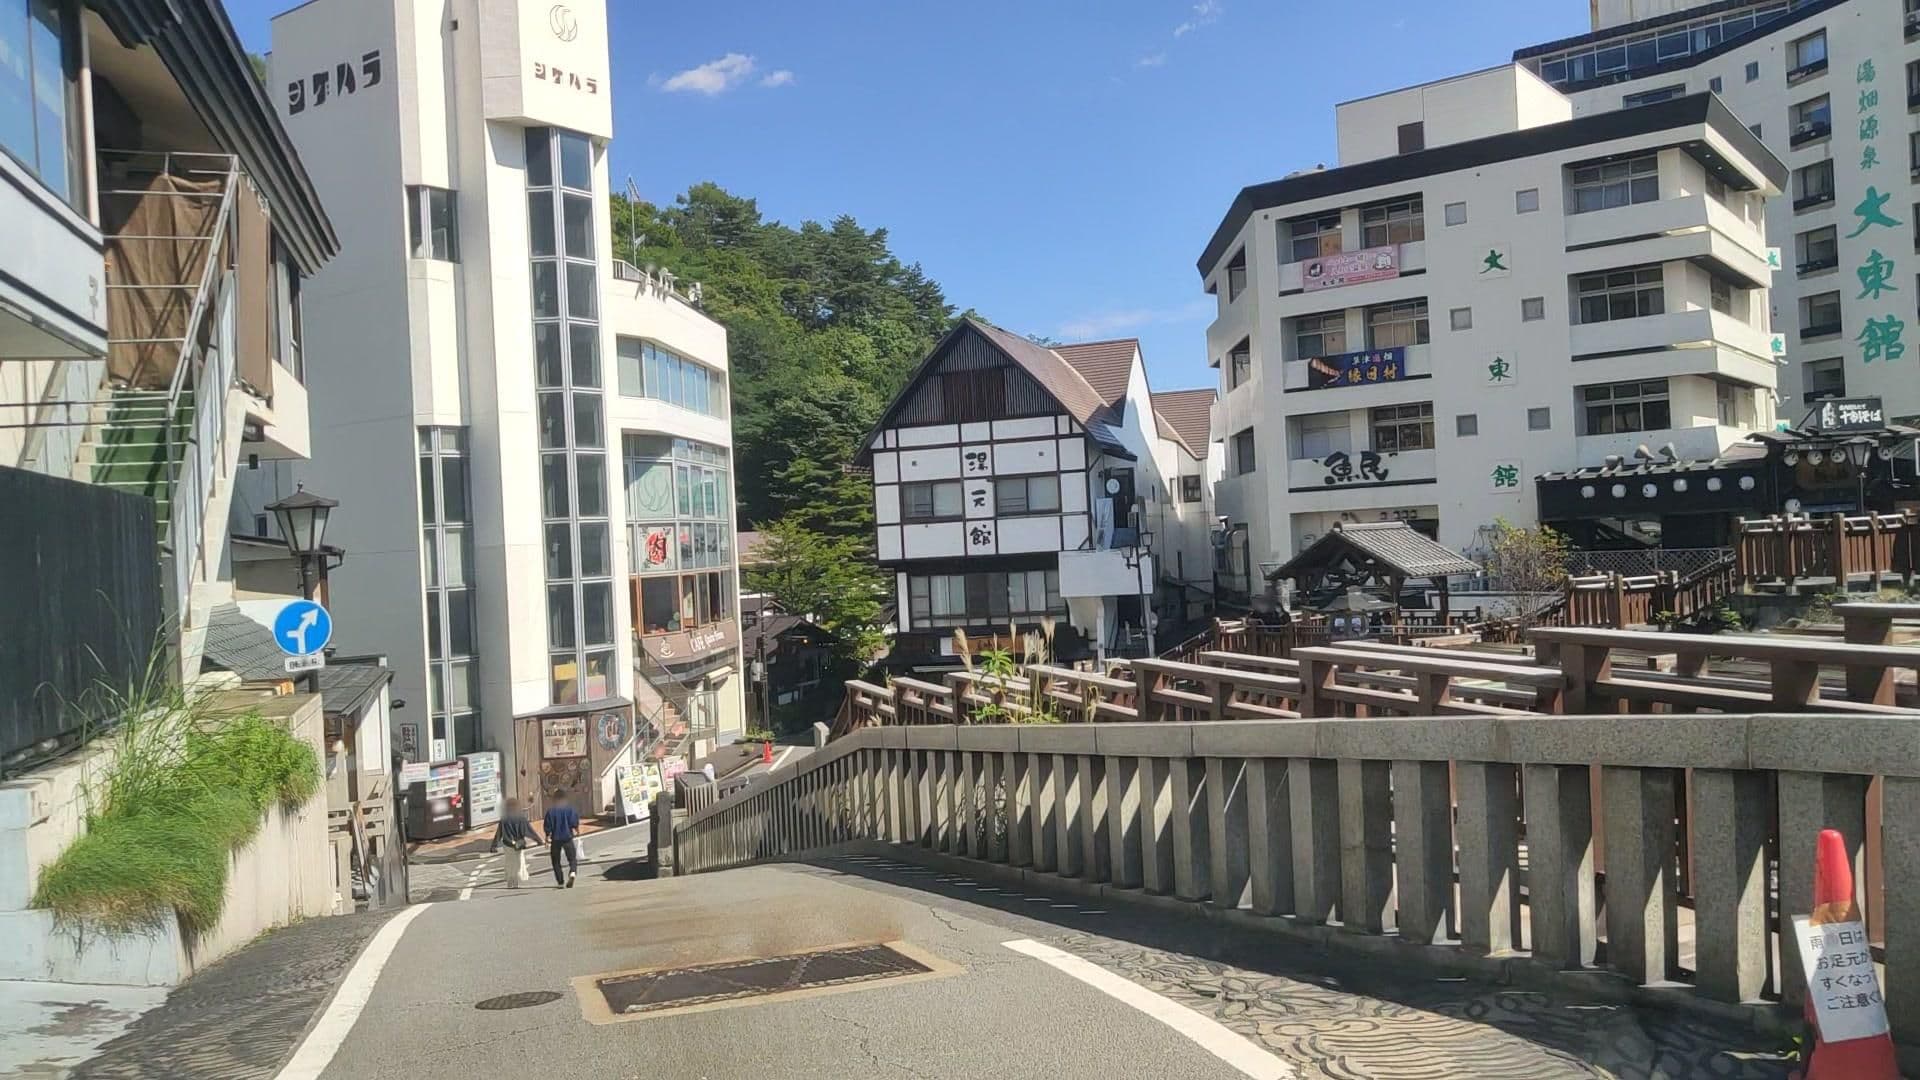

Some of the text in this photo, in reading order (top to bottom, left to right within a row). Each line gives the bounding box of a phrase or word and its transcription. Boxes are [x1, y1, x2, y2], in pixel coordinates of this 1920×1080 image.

[1856, 58, 1880, 170] 湯畑源泉
[1845, 185, 1905, 364] 大東館
[964, 451, 992, 547] 湯元館
[1323, 450, 1389, 485] 魚民
[1808, 930, 1864, 950] 雨日は
